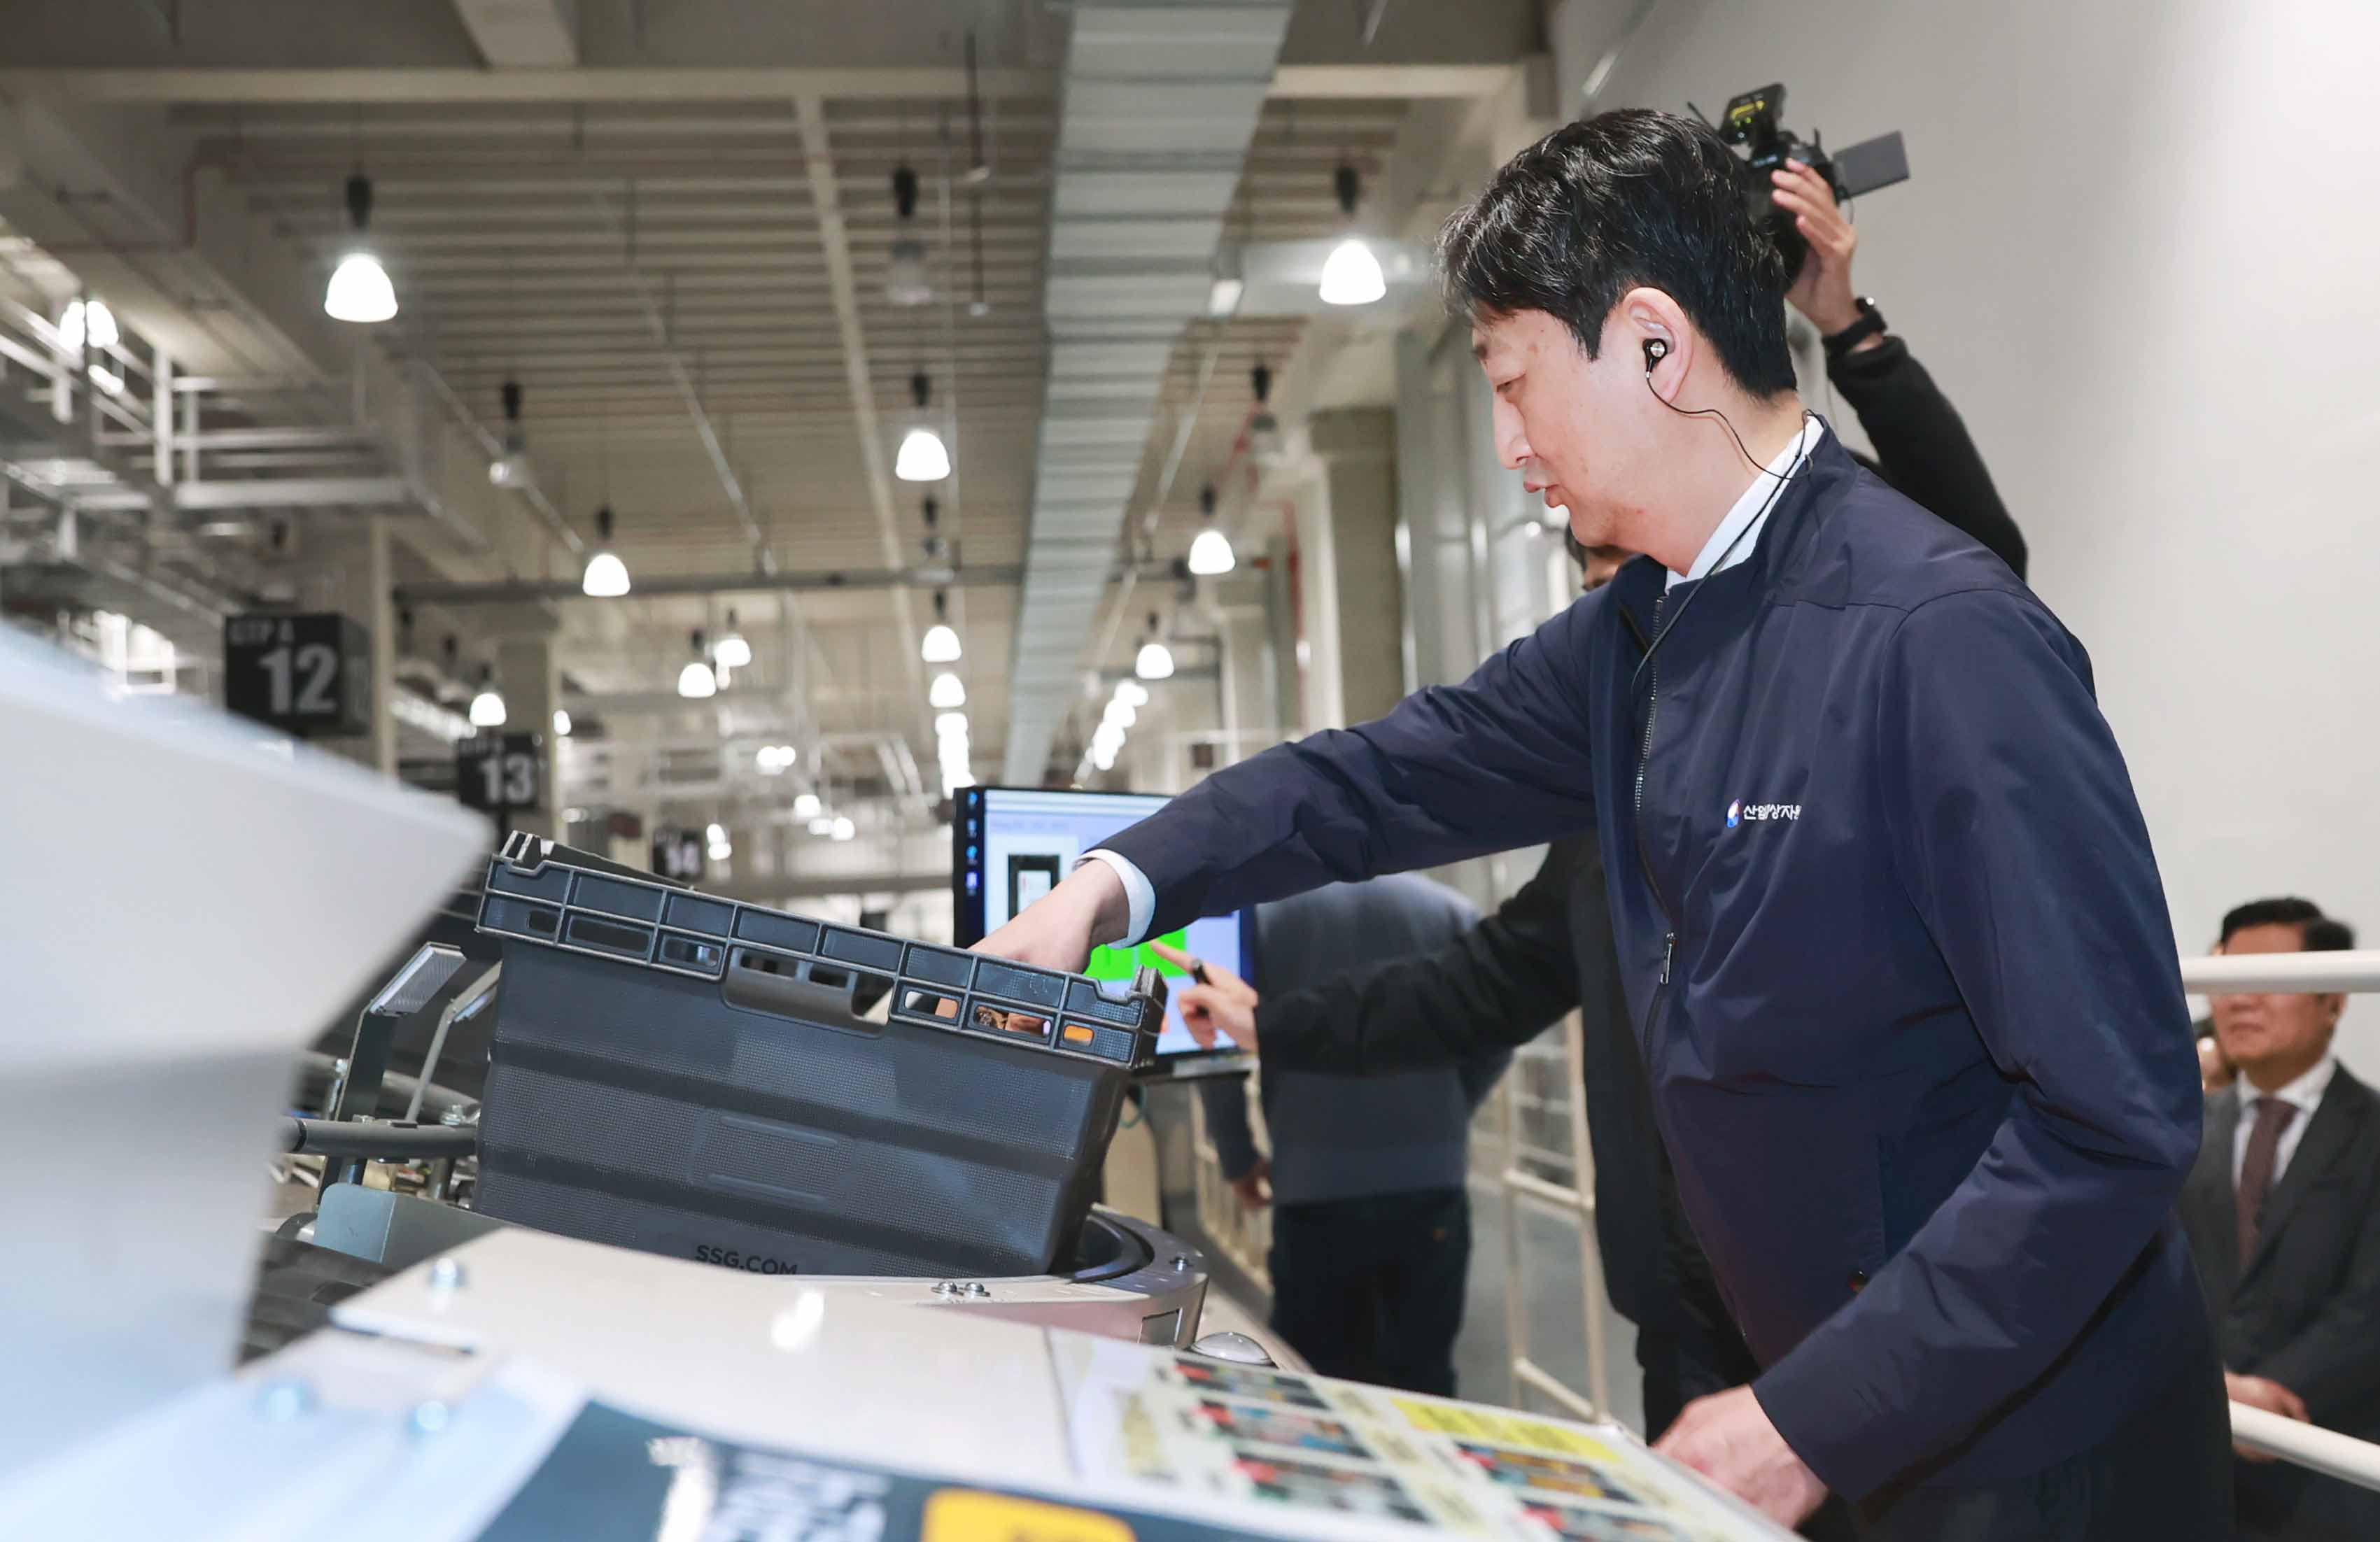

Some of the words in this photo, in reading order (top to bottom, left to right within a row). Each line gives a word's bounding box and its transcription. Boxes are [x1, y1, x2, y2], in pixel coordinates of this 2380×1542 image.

[260, 644, 337, 713] 12
[481, 754, 533, 804] 13
[695, 1245, 798, 1275] SSG.COM
